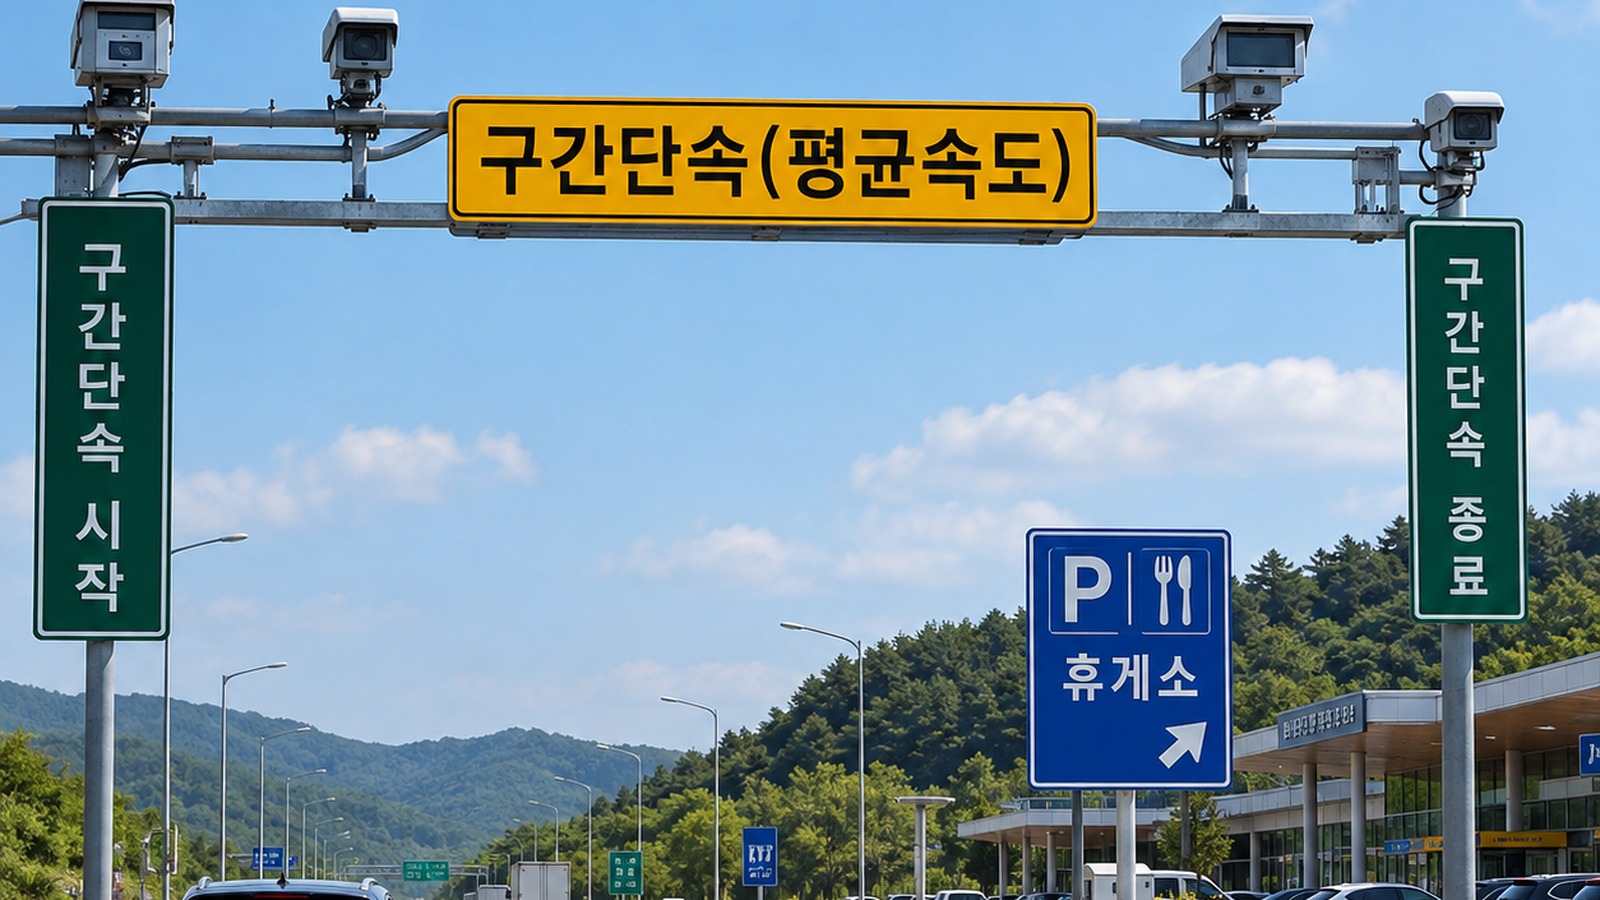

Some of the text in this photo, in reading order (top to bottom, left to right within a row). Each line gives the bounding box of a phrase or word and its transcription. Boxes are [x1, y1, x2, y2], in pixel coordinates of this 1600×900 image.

[480, 125, 1070, 202] 구간단속(평균속도)
[75, 244, 126, 612] 구간단속 시작
[1445, 258, 1488, 595] 구간단속 종료
[1064, 555, 1112, 623] P
[1063, 653, 1198, 701] 휴게소
